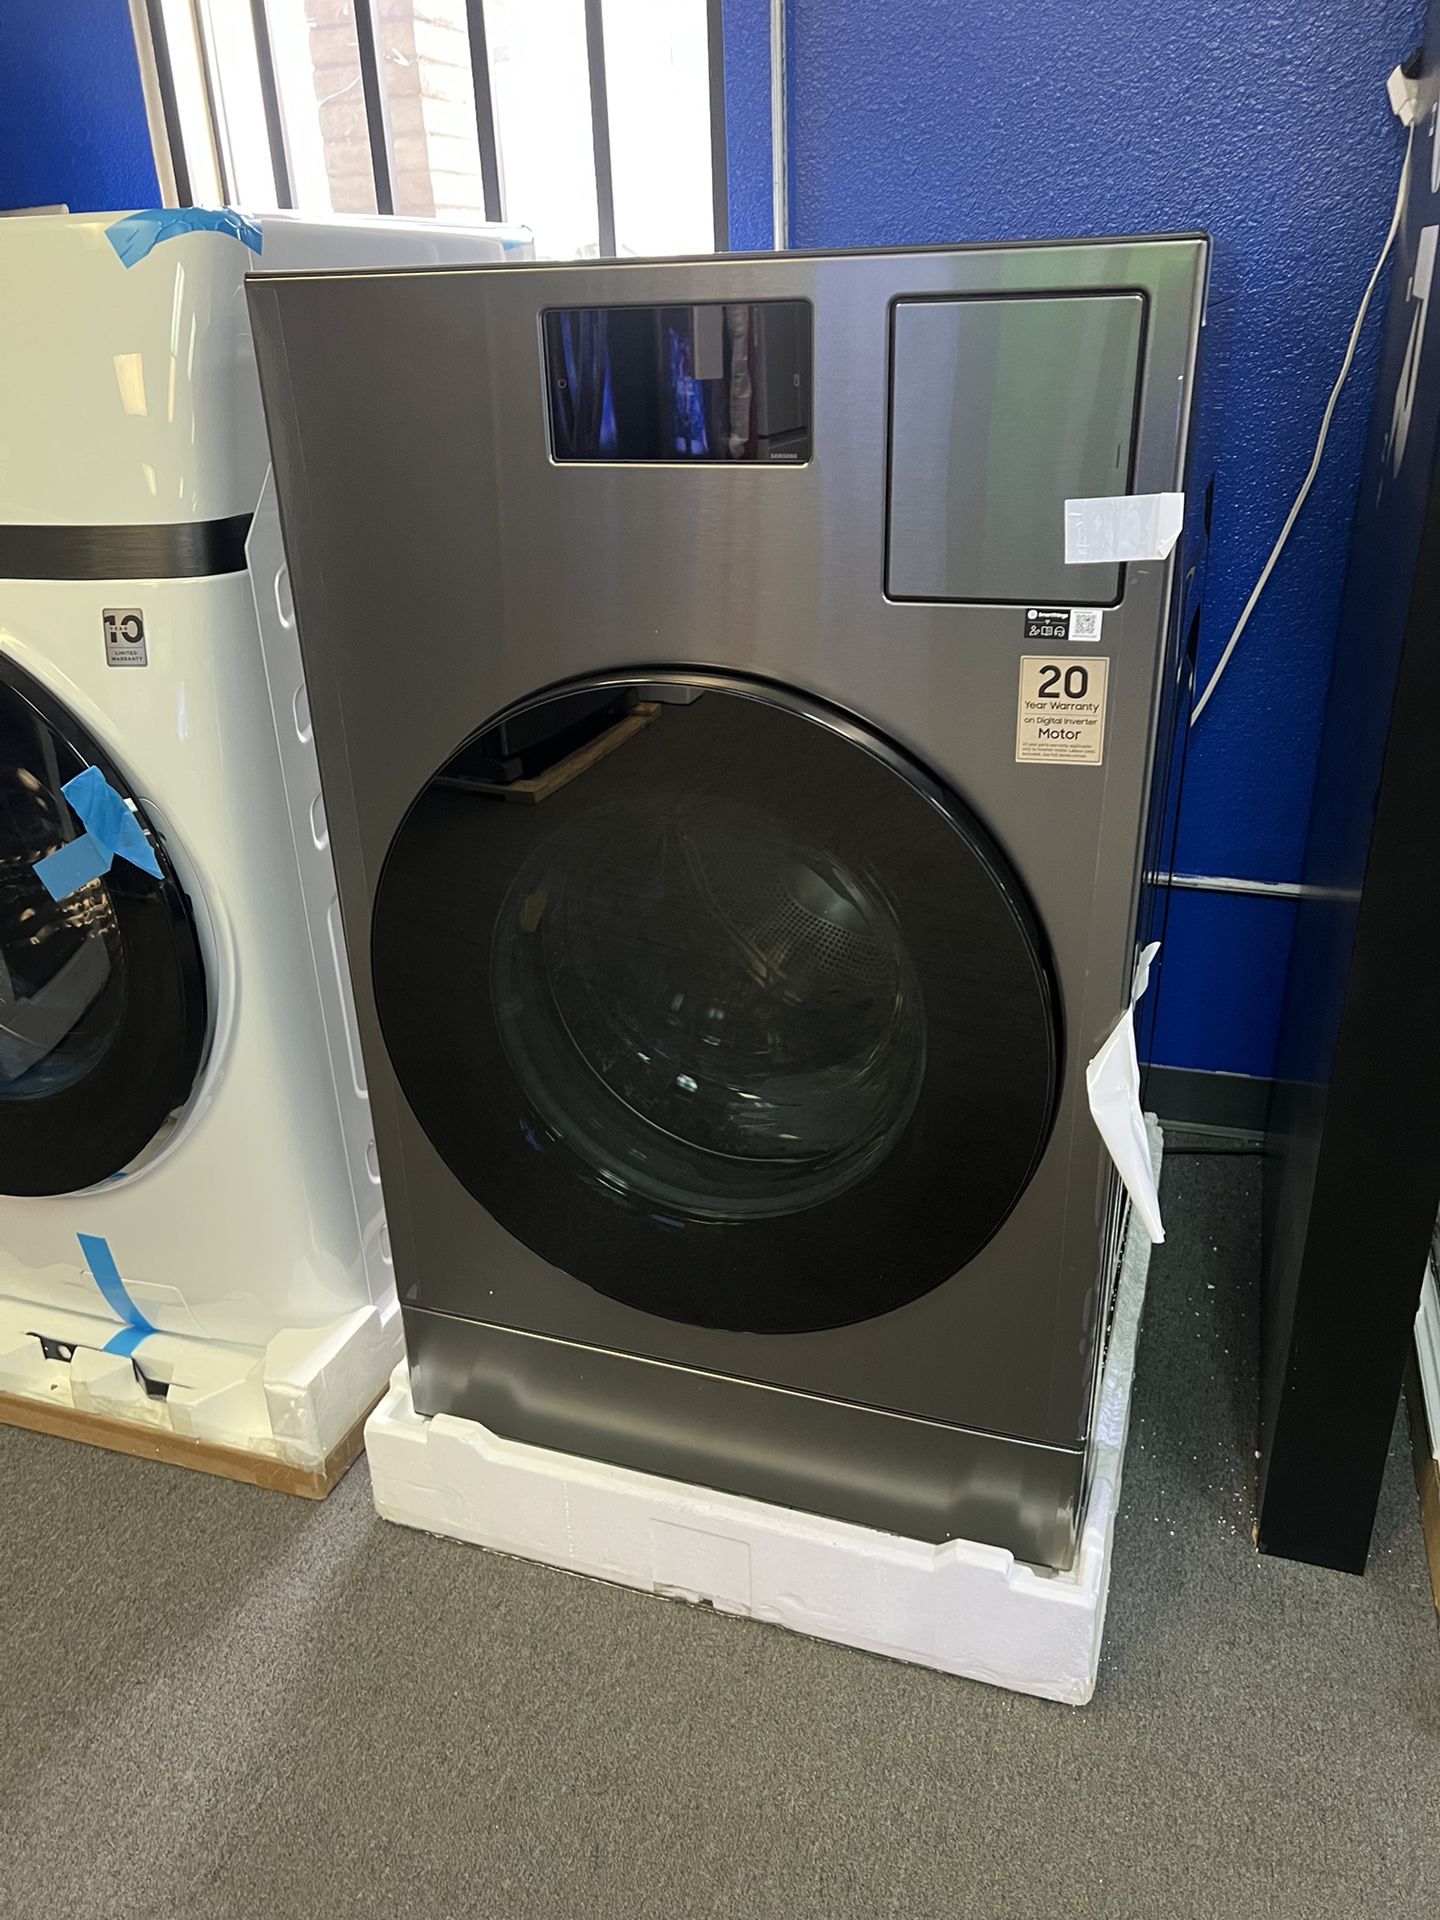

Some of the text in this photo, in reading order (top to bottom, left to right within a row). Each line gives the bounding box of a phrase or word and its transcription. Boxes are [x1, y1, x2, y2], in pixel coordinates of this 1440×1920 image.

[104, 614, 144, 643] 10
[1038, 664, 1089, 699] 20
[1025, 701, 1100, 714] Year Warranty
[1036, 716, 1063, 726] Digital
[1064, 718, 1098, 726] Inverter
[1038, 727, 1082, 740] Motor
